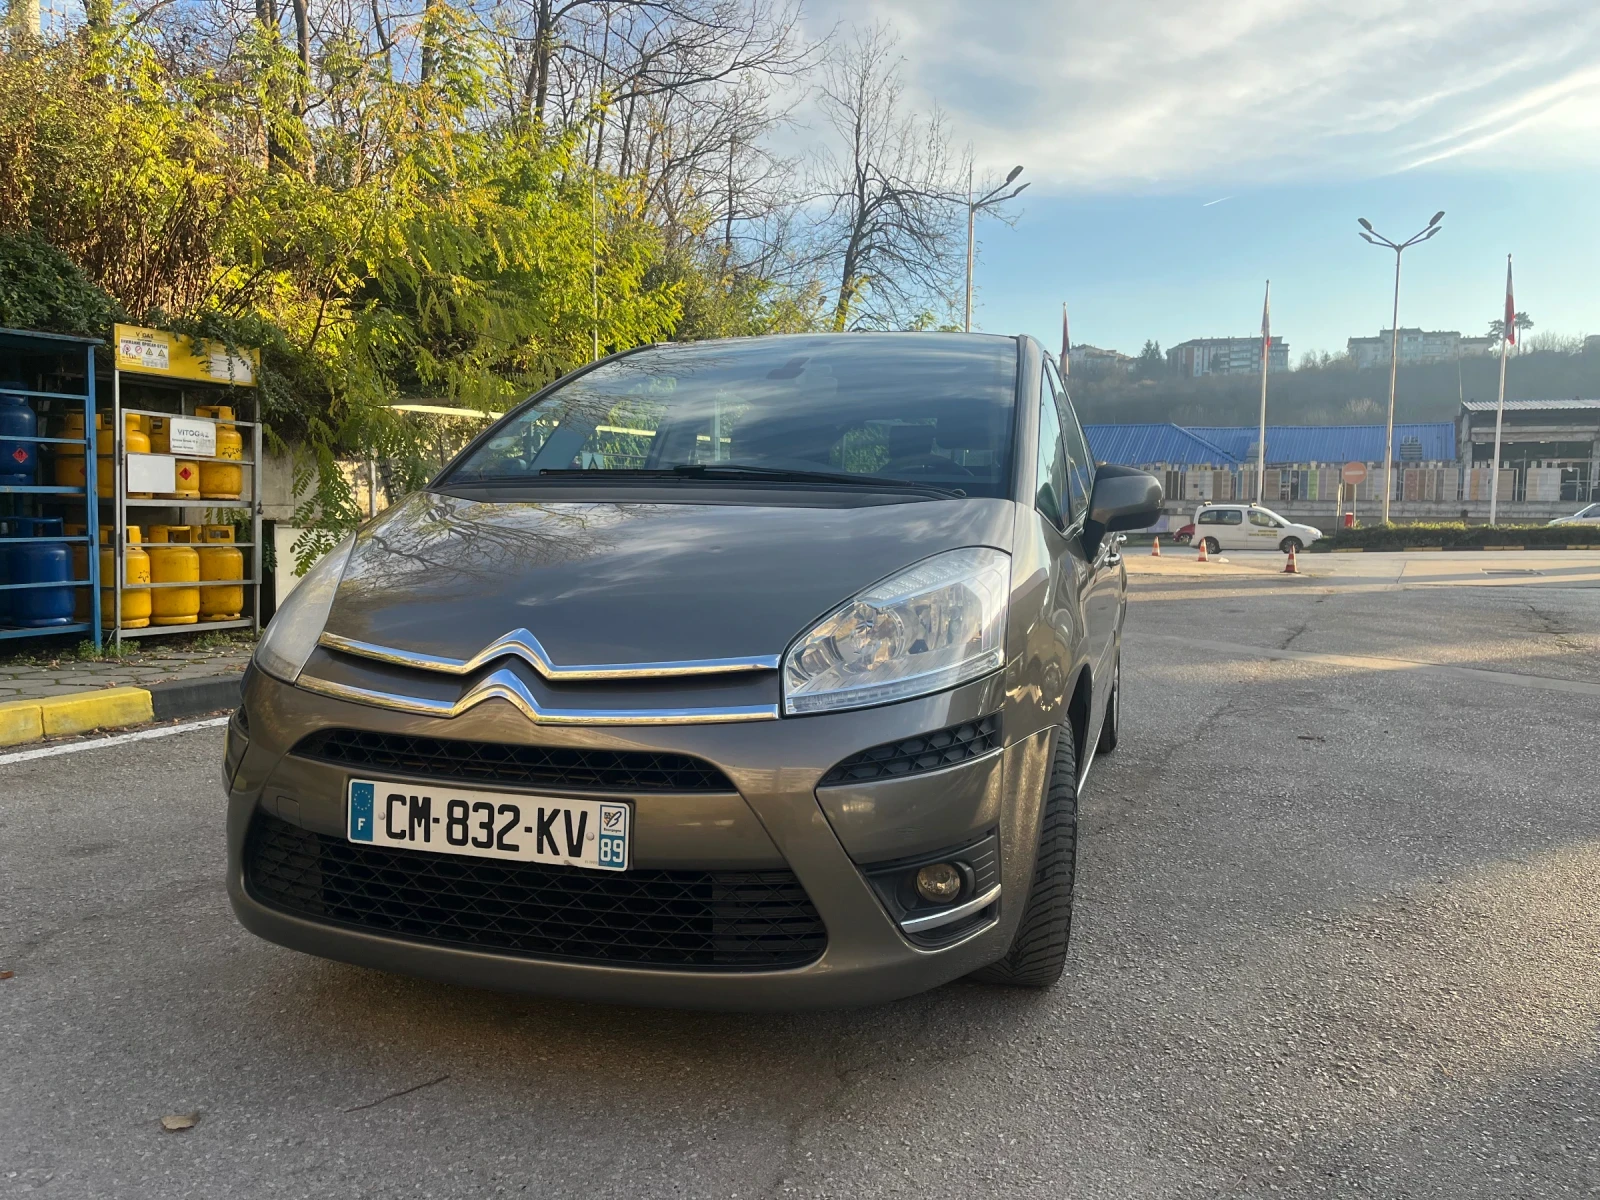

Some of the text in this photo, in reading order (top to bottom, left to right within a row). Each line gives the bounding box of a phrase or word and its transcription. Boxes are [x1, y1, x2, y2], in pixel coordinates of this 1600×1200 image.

[177, 429, 209, 438] VITOGAZ
[357, 818, 366, 830] F
[386, 794, 588, 858] CM-832-KV
[600, 838, 624, 863] 89
